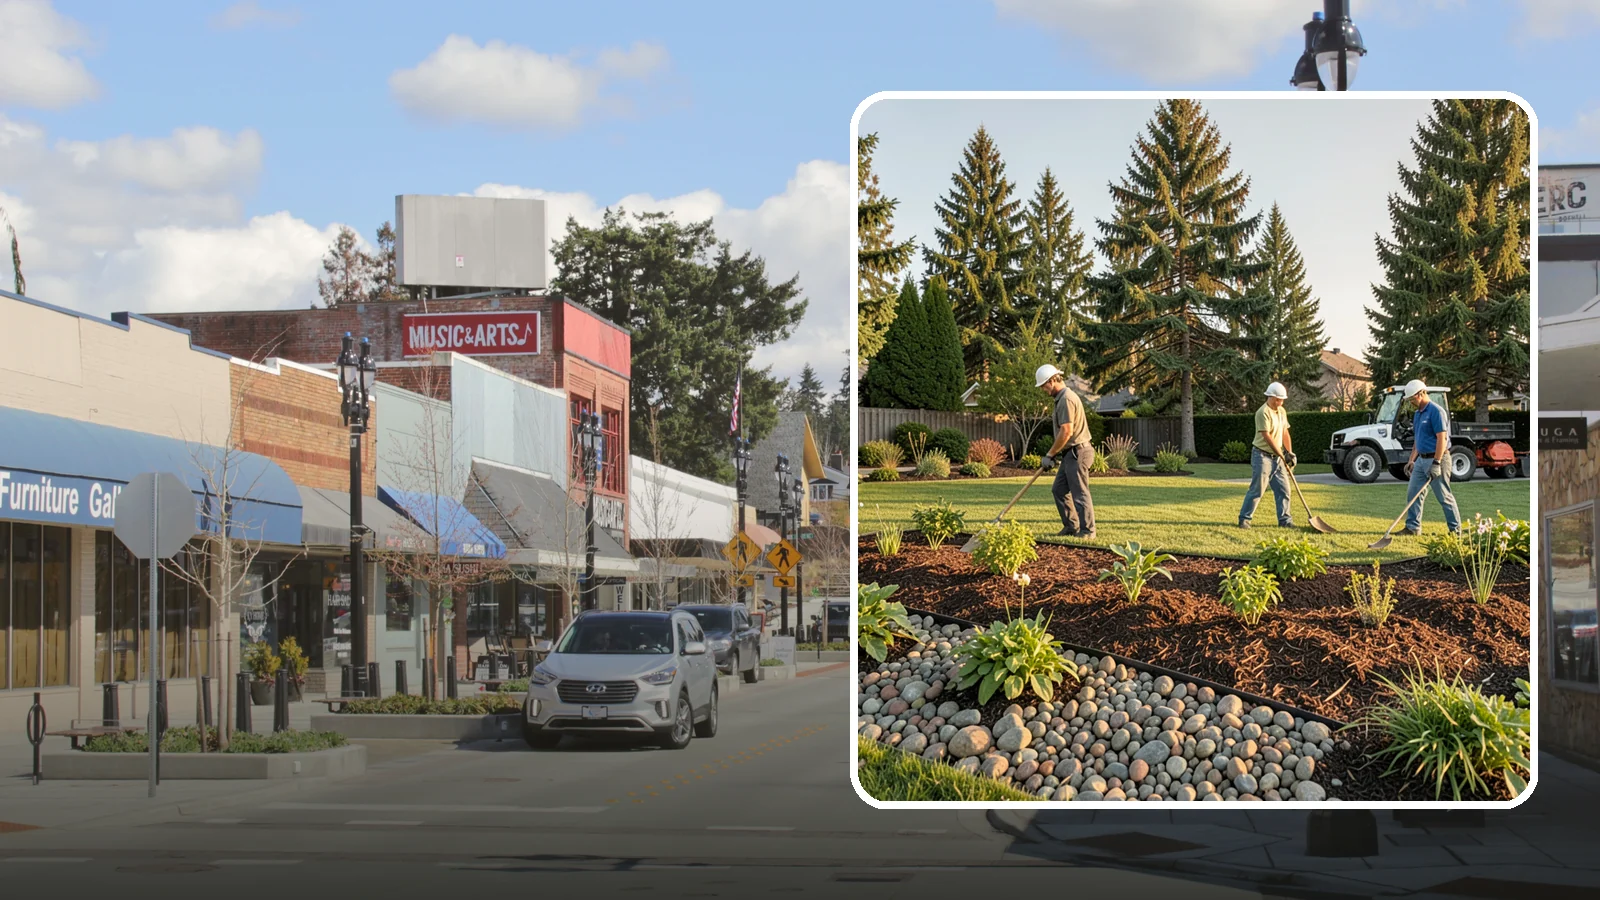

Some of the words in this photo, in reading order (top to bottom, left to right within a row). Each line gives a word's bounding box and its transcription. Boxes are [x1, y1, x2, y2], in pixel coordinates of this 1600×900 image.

[409, 323, 520, 349] MUSIC&ARTS
[0, 471, 79, 515] Furniture
[89, 482, 121, 519] Gal
